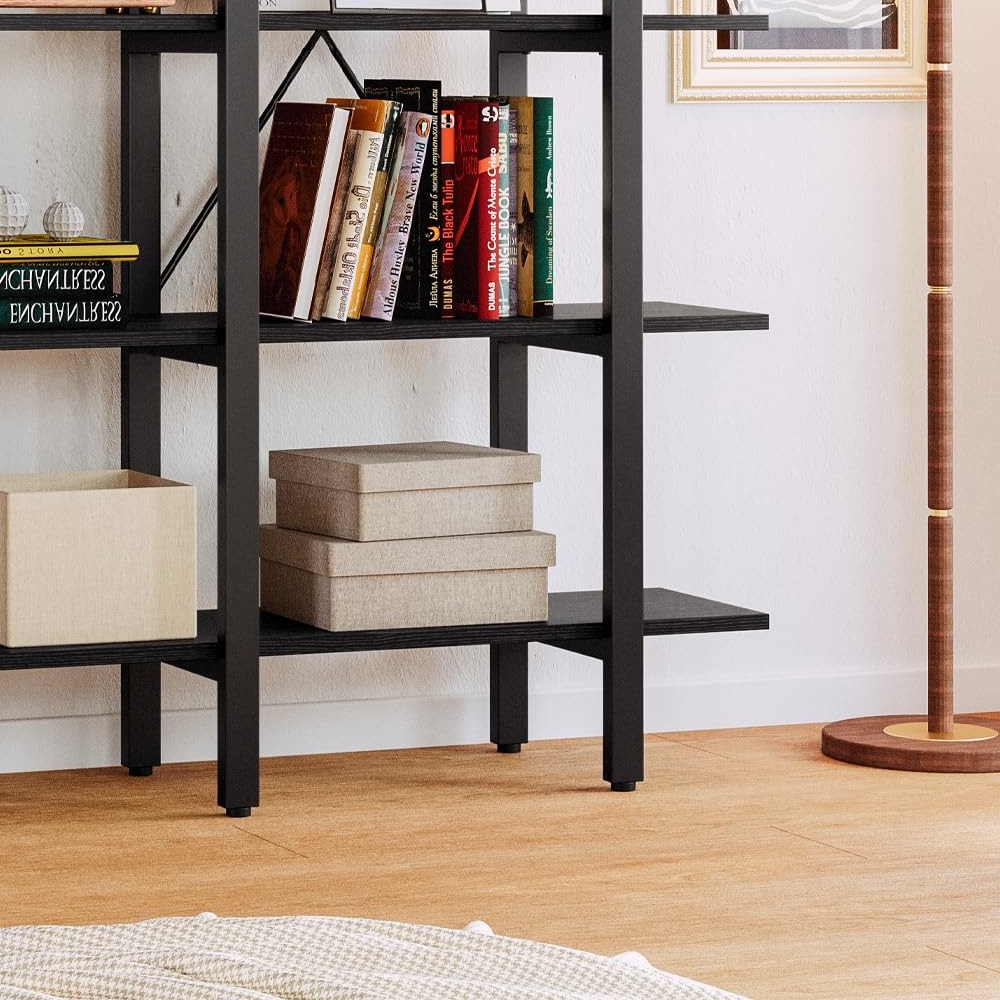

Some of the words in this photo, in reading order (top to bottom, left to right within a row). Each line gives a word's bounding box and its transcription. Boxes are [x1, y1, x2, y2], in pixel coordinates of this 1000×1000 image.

[545, 115, 553, 136] Brown
[411, 141, 426, 185] World
[498, 132, 508, 174] SABU
[545, 136, 553, 161] Andrew
[407, 177, 418, 200] New
[442, 179, 455, 206] Tulip
[487, 178, 497, 209] Monte
[399, 201, 414, 235] Brave
[442, 208, 454, 239] Black
[487, 210, 497, 220] of
[498, 187, 510, 229] BOOK
[545, 206, 553, 236] Sweden
[487, 220, 497, 251] Count
[545, 237, 553, 246] of
[389, 236, 407, 277] Huxley
[442, 242, 454, 263] The
[487, 252, 497, 272] The
[498, 234, 510, 283] JUNGLE
[545, 247, 553, 285] Dreaming
[383, 277, 400, 316] Aldous
[443, 278, 453, 310] DUMAS
[488, 281, 496, 311] DUMAS
